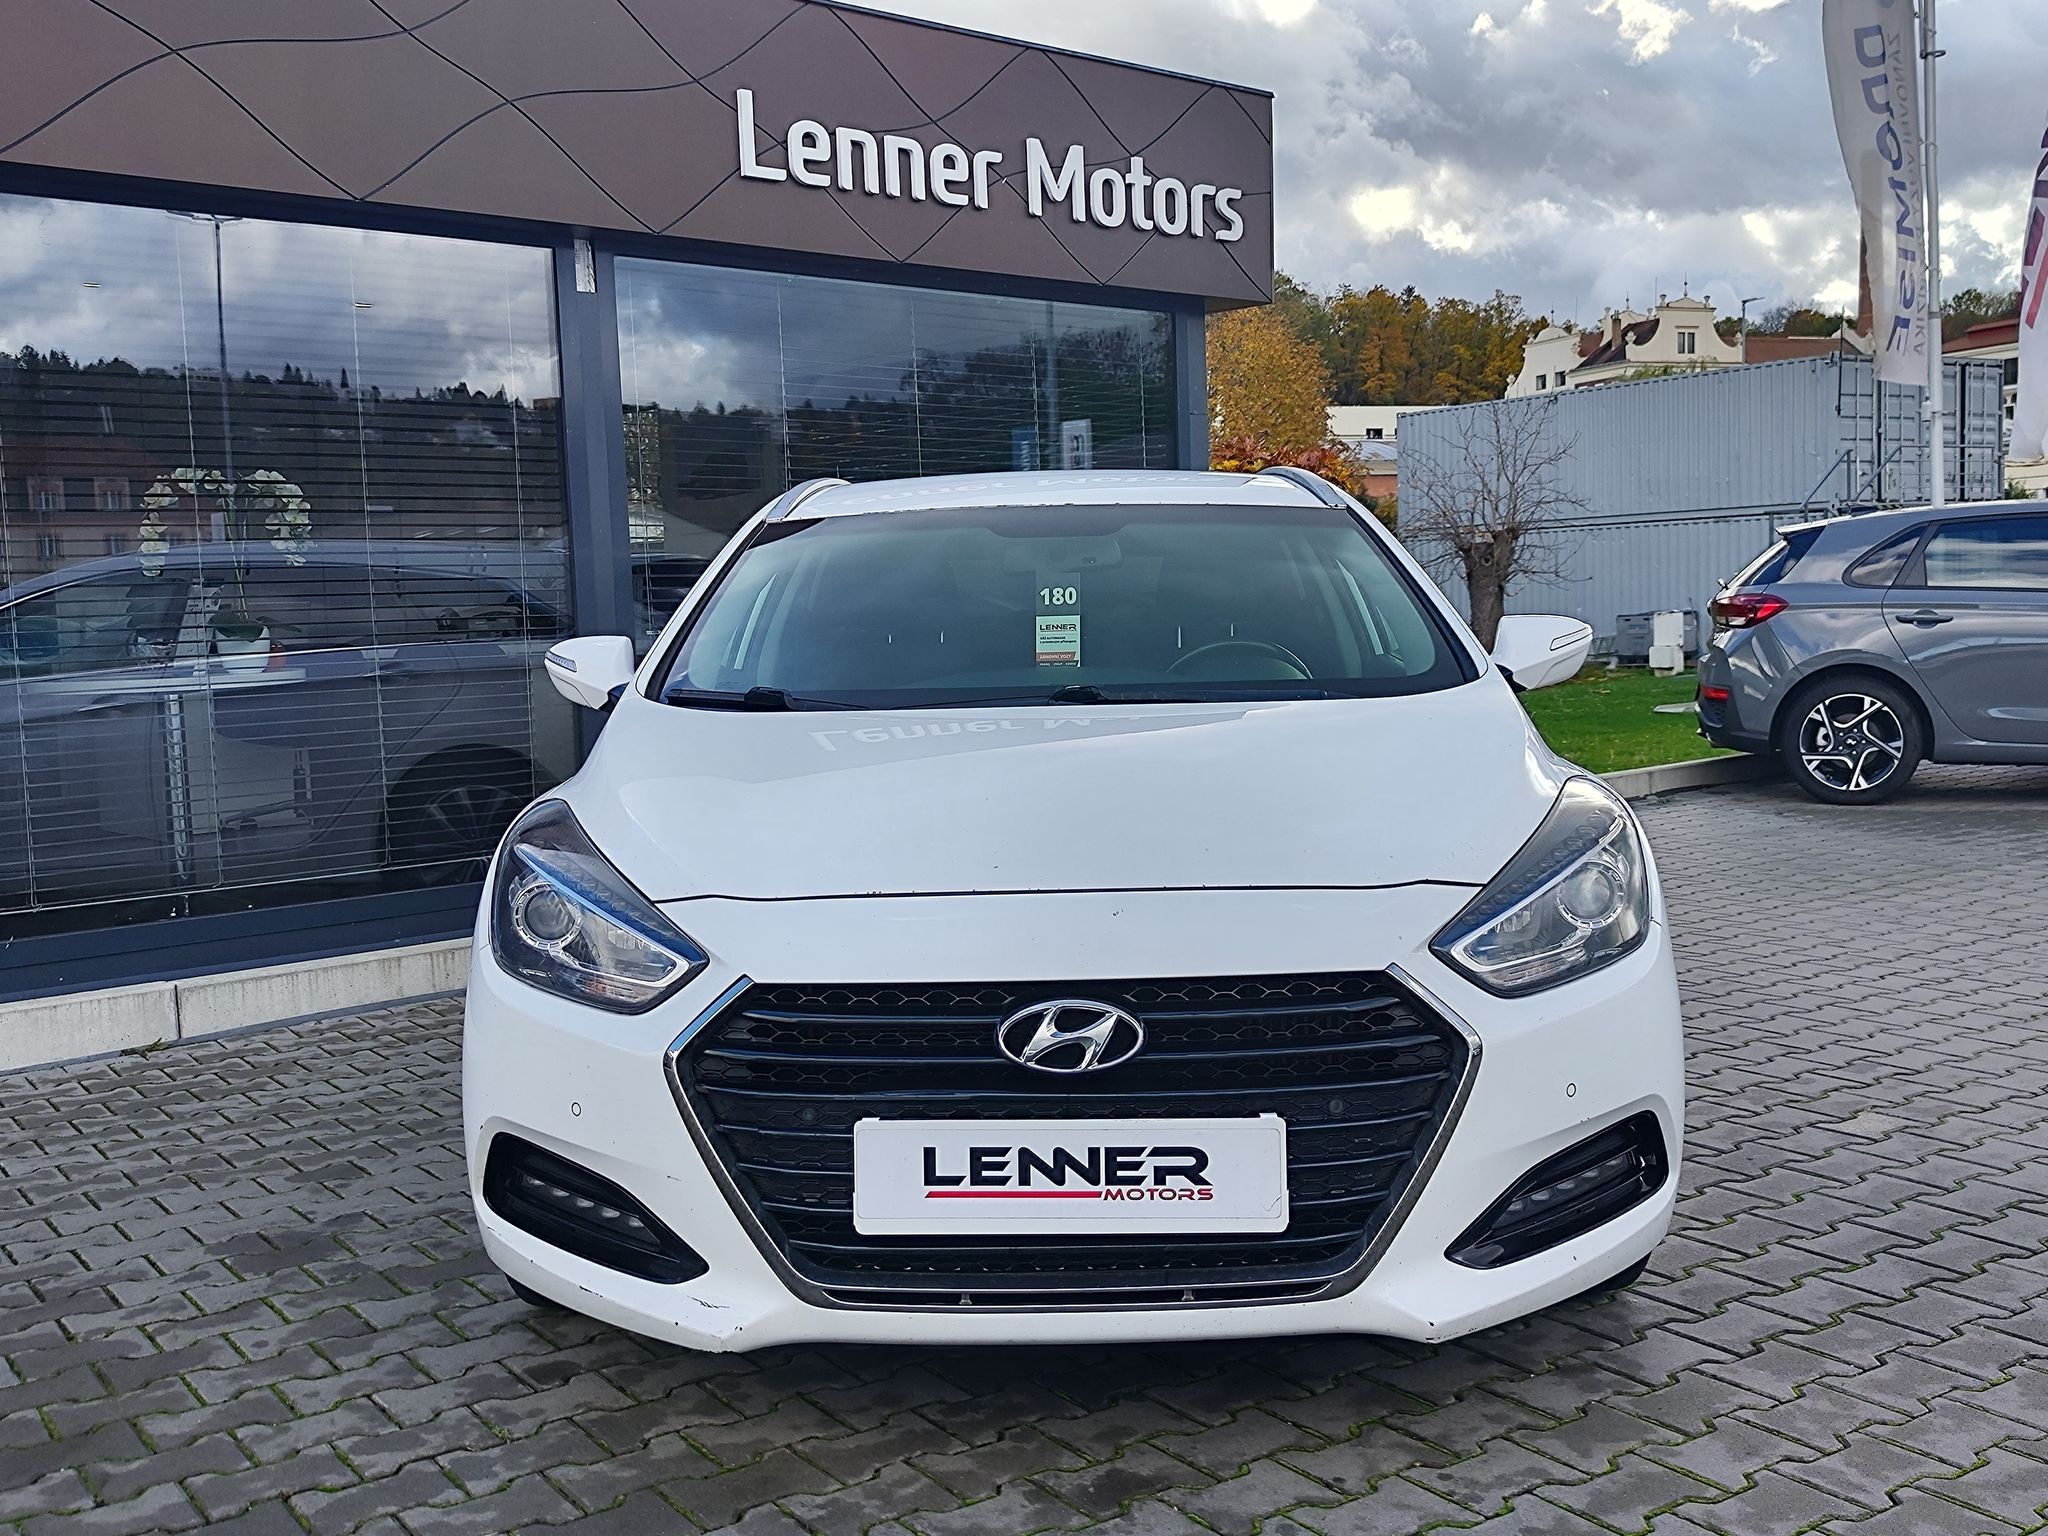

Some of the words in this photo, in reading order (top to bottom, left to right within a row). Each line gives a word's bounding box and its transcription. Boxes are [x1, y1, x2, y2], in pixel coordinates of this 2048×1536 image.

[735, 88, 1002, 210] Lenner
[1026, 137, 1245, 242] Motors
[1040, 586, 1077, 606] 180
[1040, 623, 1077, 631] LENNER
[922, 1146, 1214, 1187] LENNER
[1102, 1187, 1214, 1202] MOTORS
